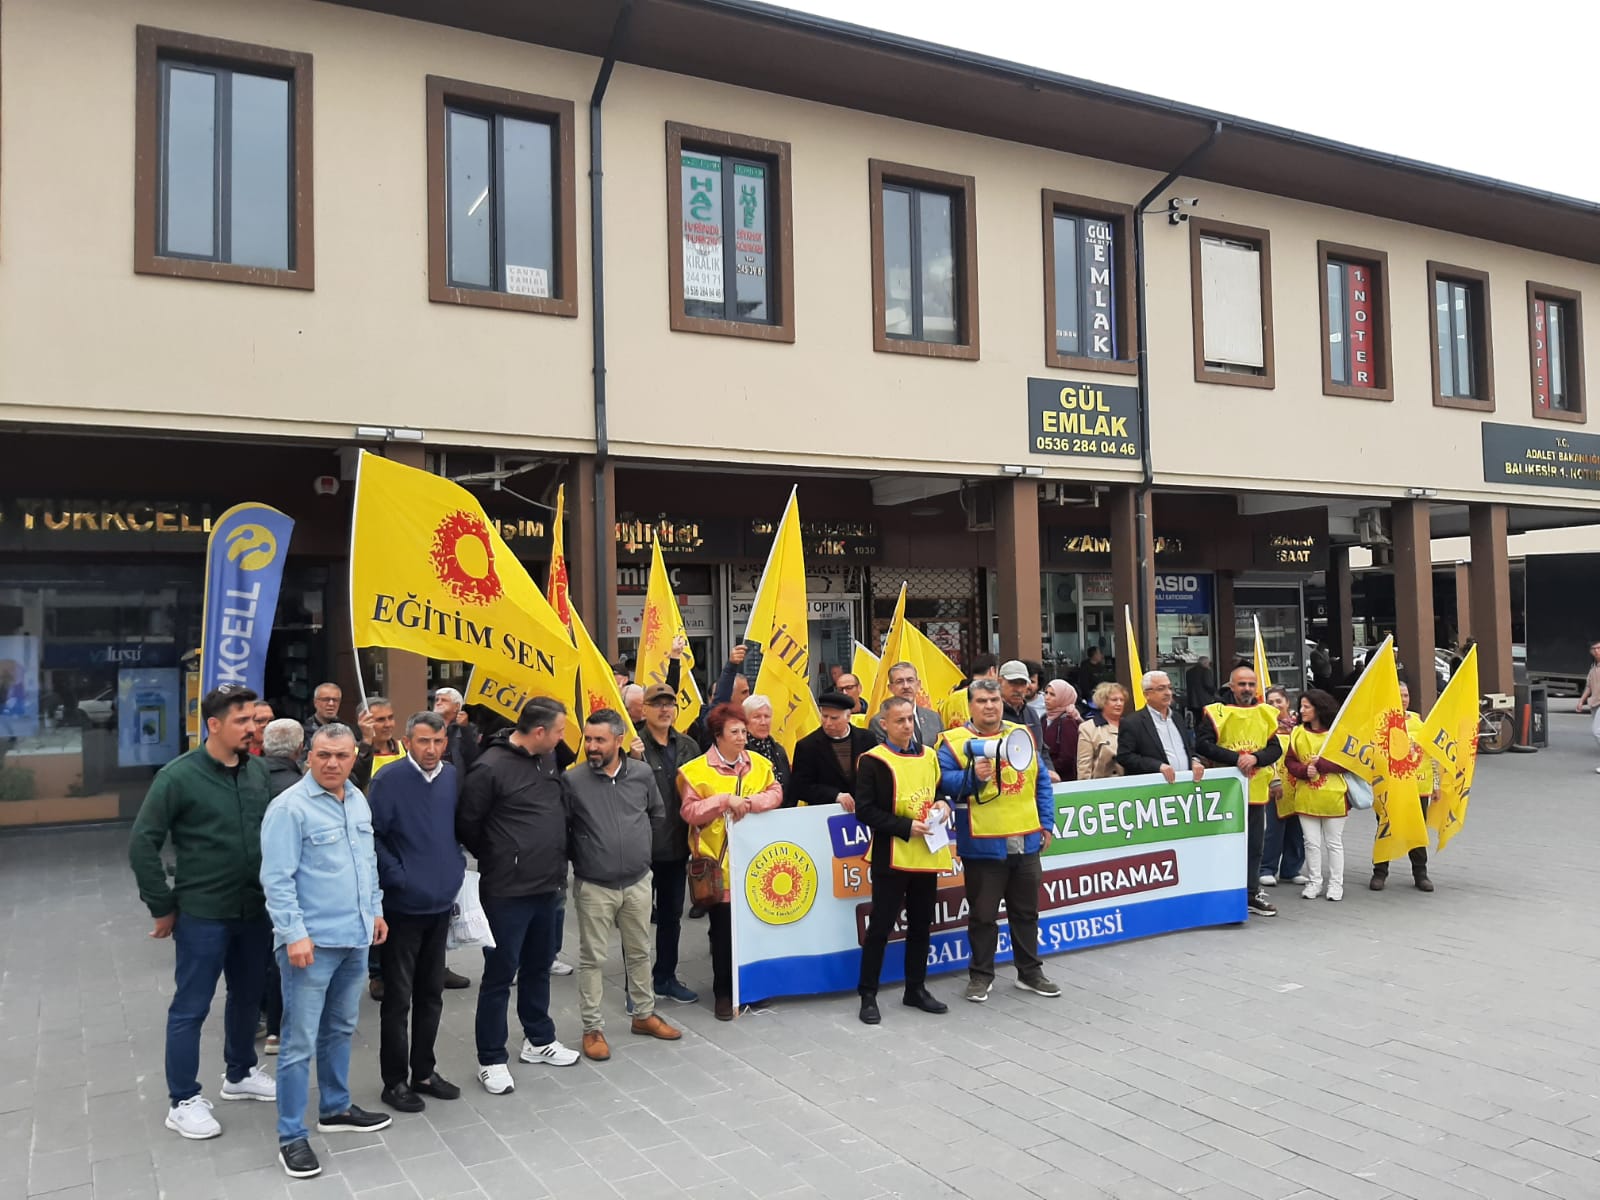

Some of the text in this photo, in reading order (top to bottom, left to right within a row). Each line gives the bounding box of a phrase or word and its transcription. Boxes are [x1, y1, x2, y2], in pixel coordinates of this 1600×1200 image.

[689, 176, 713, 222] HAC
[1088, 223, 1111, 241] GÜL
[1090, 244, 1110, 353] EMLAK
[1354, 290, 1368, 382] NOTER
[1060, 384, 1110, 412] GÜL
[1042, 410, 1128, 438] EMLAK
[1036, 436, 1136, 456] 0536 284 04 46
[1526, 448, 1556, 461] ADALET
[1505, 461, 1558, 477] BALIKESİR
[1277, 549, 1311, 562] SAAT
[1154, 575, 1198, 592] ASIO
[371, 592, 556, 678] EĞİTİM SEN
[1052, 786, 1234, 839] AZGEÇMEYİZ.
[843, 863, 861, 892] İŞ
[1043, 860, 1174, 903] YILDIRAMAZ
[1050, 909, 1124, 949] ŞUBESİ
